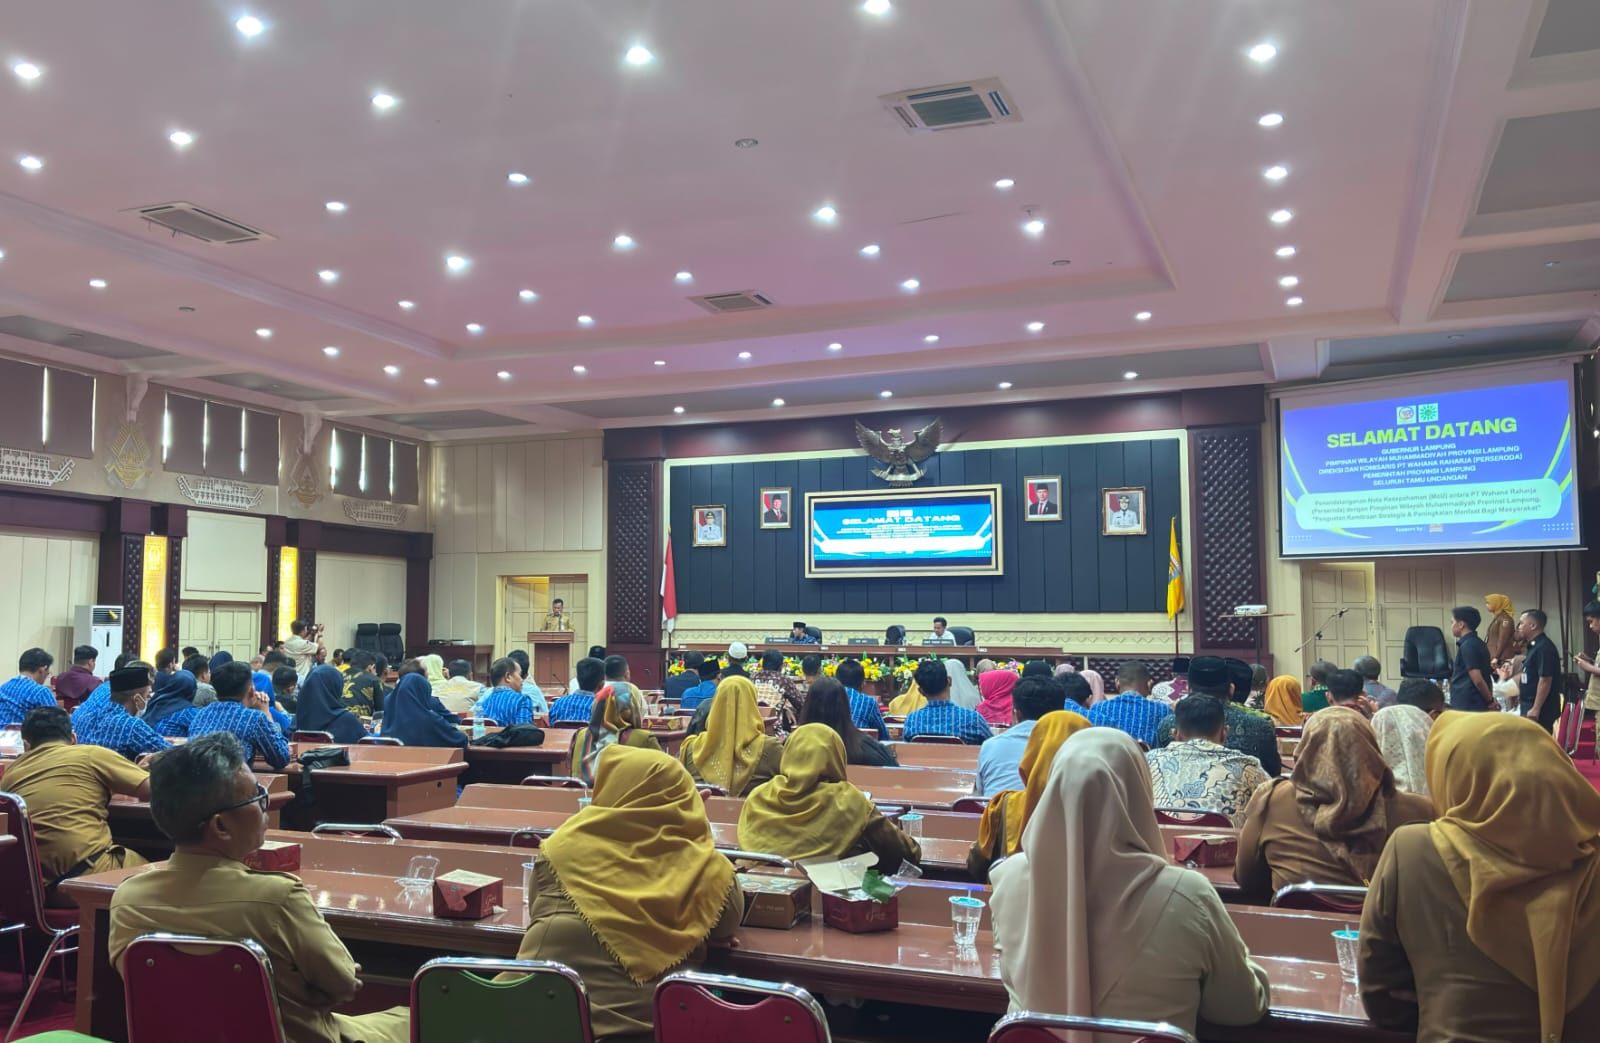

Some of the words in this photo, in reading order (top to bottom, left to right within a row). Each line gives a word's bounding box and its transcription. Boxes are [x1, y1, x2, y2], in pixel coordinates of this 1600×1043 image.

[1327, 426, 1420, 448] SELAMAT
[1426, 417, 1517, 440] DATANG
[1358, 456, 1388, 464] WILAYAH
[1448, 448, 1482, 457] PROVINSI
[1483, 445, 1520, 454] LAMPUNG
[1382, 446, 1419, 455] GUBERNUR
[1420, 443, 1456, 452] LAMPUNG
[1408, 459, 1438, 468] WAHANA
[1440, 457, 1472, 465] RAHARJA
[1474, 453, 1523, 464] (PERSERODA)
[1407, 467, 1439, 476] PROVINSI
[1440, 465, 1476, 474] LAMPUNG
[1406, 476, 1425, 484] TAMU
[1426, 474, 1468, 483] UNDANGAN
[1426, 499, 1476, 508] Muhammadiyah
[1477, 496, 1505, 504] Provinsi
[1481, 506, 1497, 514] Bagi
[842, 518, 902, 526] SELAMAT
[904, 514, 960, 523] DATANG
